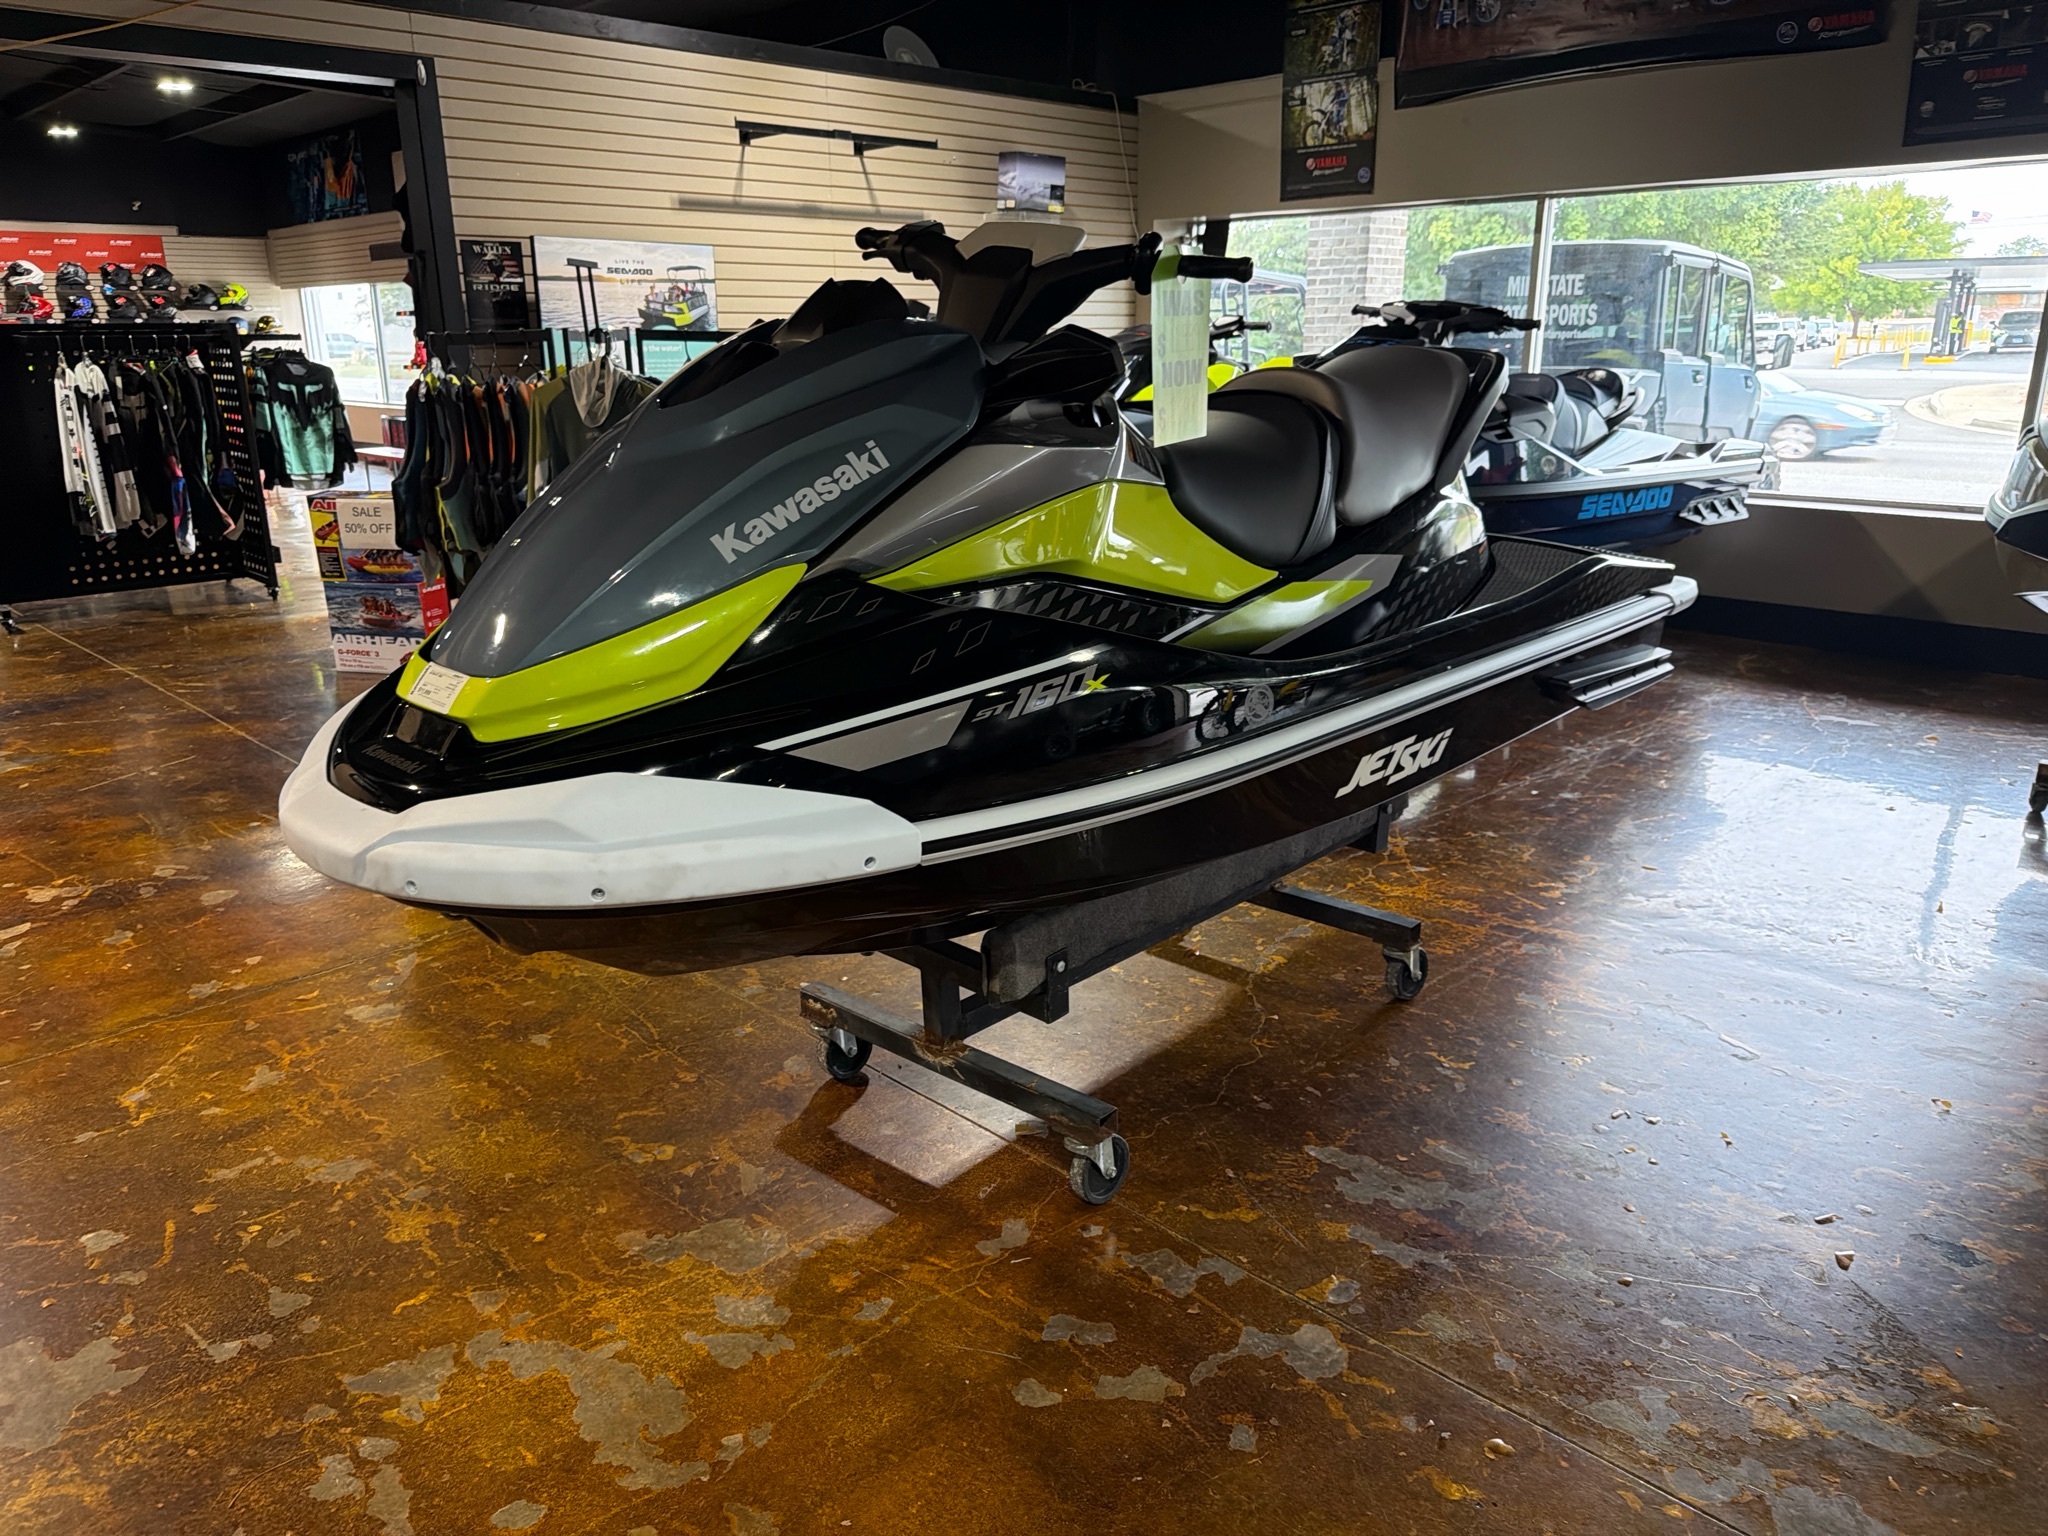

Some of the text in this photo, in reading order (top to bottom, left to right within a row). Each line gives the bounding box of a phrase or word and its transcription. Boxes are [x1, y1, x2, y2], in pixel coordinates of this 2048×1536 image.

[1315, 155, 1348, 169] YAMAHA
[619, 278, 643, 286] LIFE
[1546, 273, 1585, 297] TATE
[1162, 289, 1205, 317] WAS
[648, 344, 660, 352] the
[1161, 358, 1204, 389] NOW
[709, 439, 891, 564] Kawasaki
[352, 506, 382, 518] SALE
[344, 523, 393, 534] 50% OFF
[337, 648, 371, 657] G-FORCE
[361, 743, 428, 775] Kawasaki
